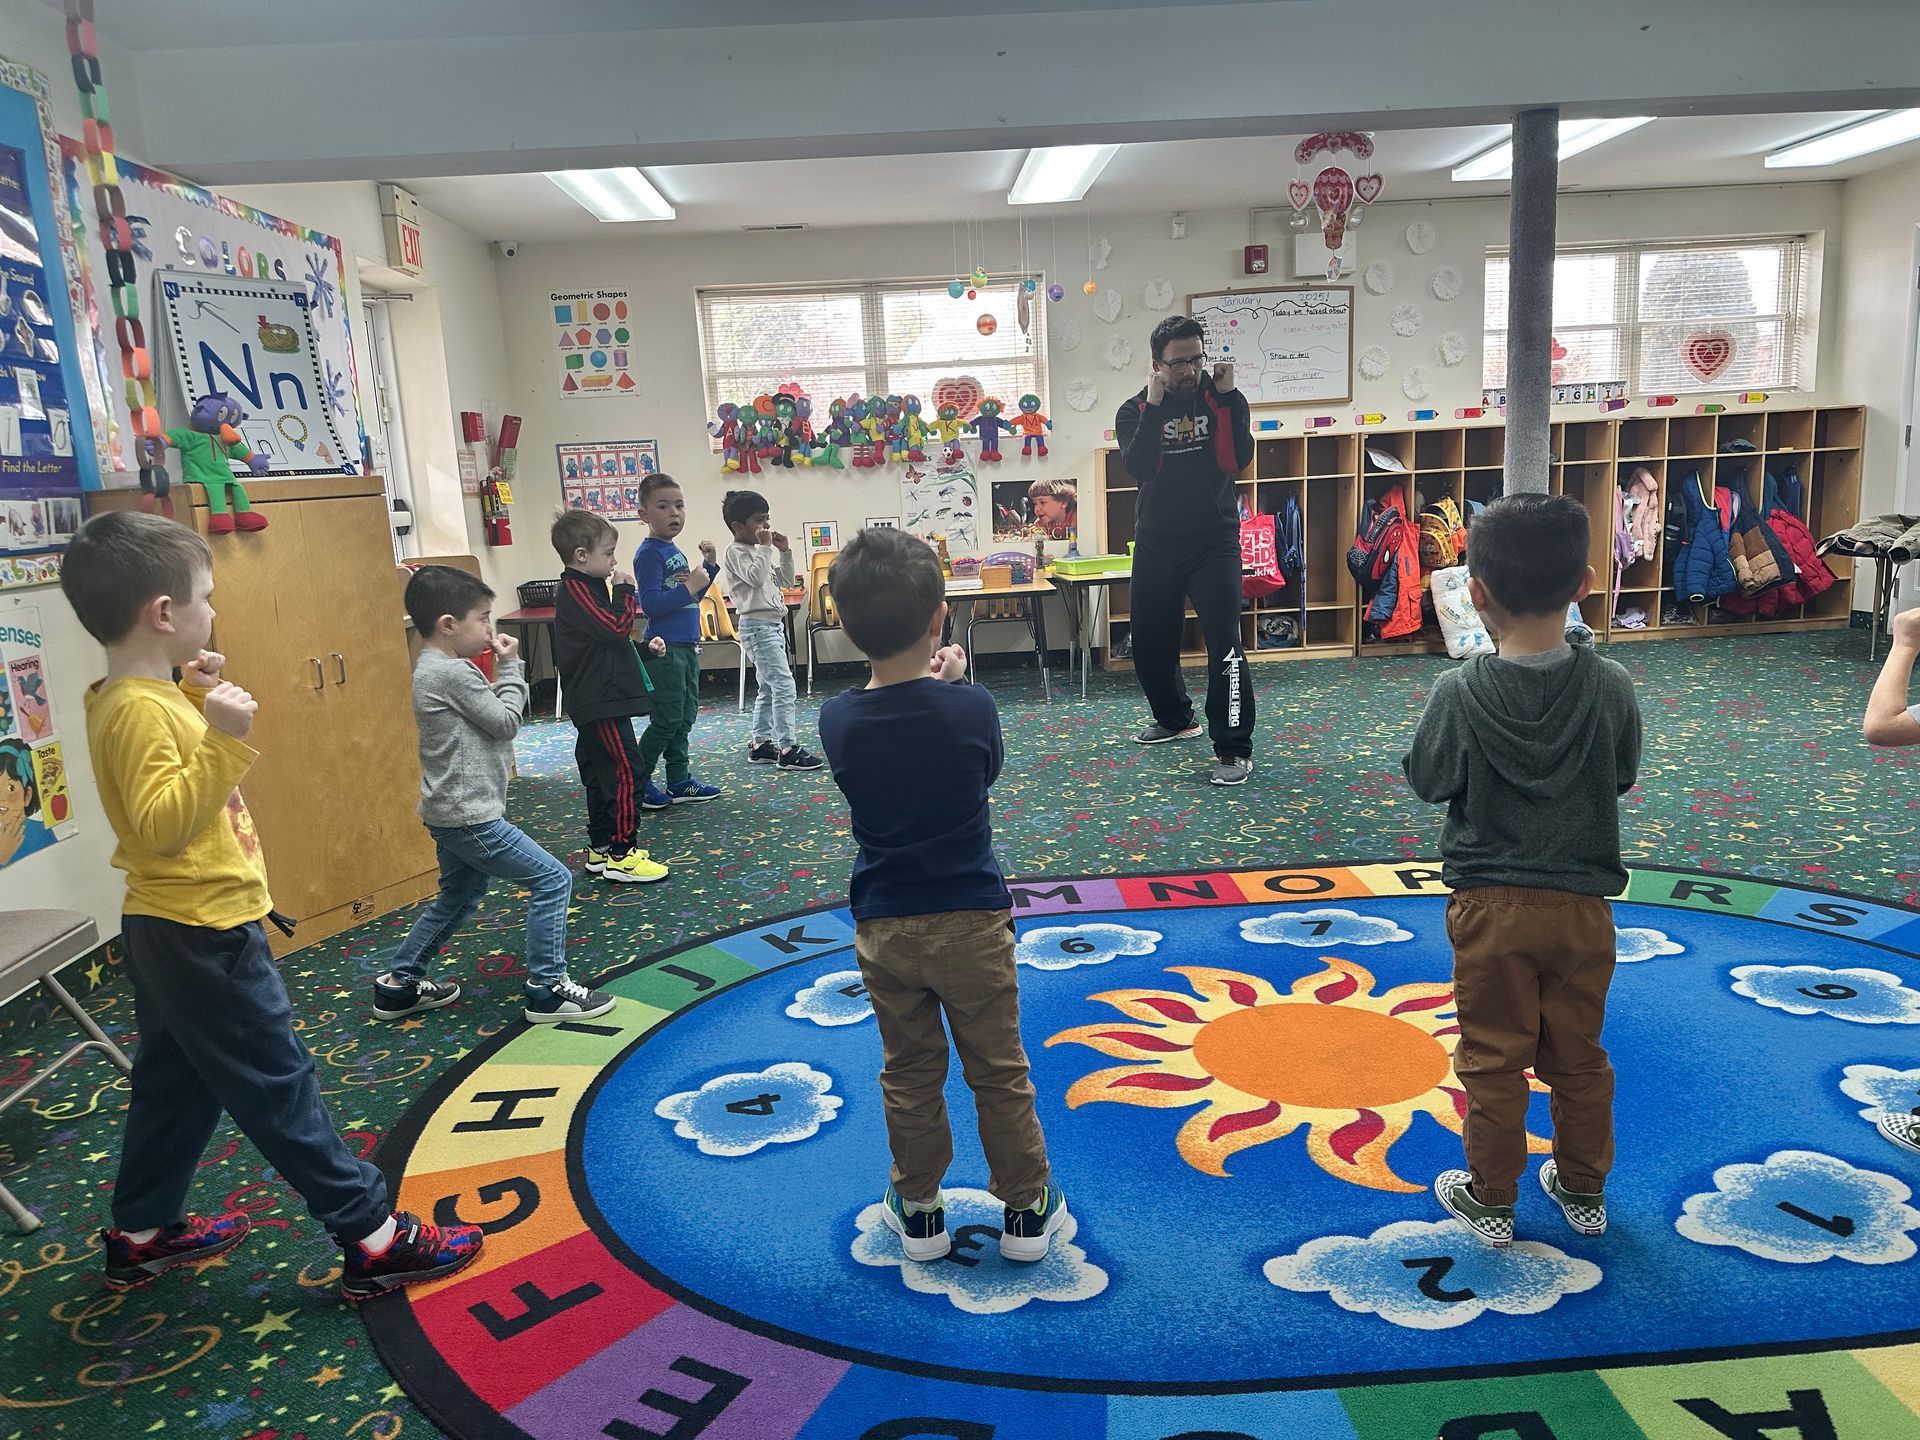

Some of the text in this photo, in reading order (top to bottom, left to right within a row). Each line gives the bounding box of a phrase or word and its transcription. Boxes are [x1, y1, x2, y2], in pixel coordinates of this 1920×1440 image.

[175, 226, 287, 281] COLORS
[401, 223, 423, 268] EXIT
[551, 291, 627, 300] Geometric Shapes
[1220, 292, 1329, 307] January 2025!
[1272, 309, 1290, 317] Today
[1482, 396, 1489, 406] A
[1559, 393, 1565, 401] F
[1574, 391, 1581, 400] G
[1587, 390, 1595, 399] H
[946, 420, 955, 433] K
[1026, 417, 1037, 427] M
[3, 460, 62, 473] Find the Letter
[11, 660, 39, 673] Hearing
[36, 746, 56, 759] Taste
[1146, 878, 1220, 902] N
[1264, 874, 1337, 895] O
[1669, 880, 1734, 906] R
[1011, 885, 1083, 908] M
[1795, 903, 1869, 928] S
[760, 925, 839, 954] K
[1300, 920, 1335, 937] 7
[1060, 937, 1096, 954] 6
[657, 964, 704, 991] J
[451, 1087, 557, 1133] H
[725, 1093, 781, 1116] 4
[433, 1176, 541, 1236] G
[1775, 1201, 1855, 1238] 1
[1401, 1255, 1477, 1302] 2
[467, 1280, 604, 1341] F
[602, 1355, 753, 1440] E
